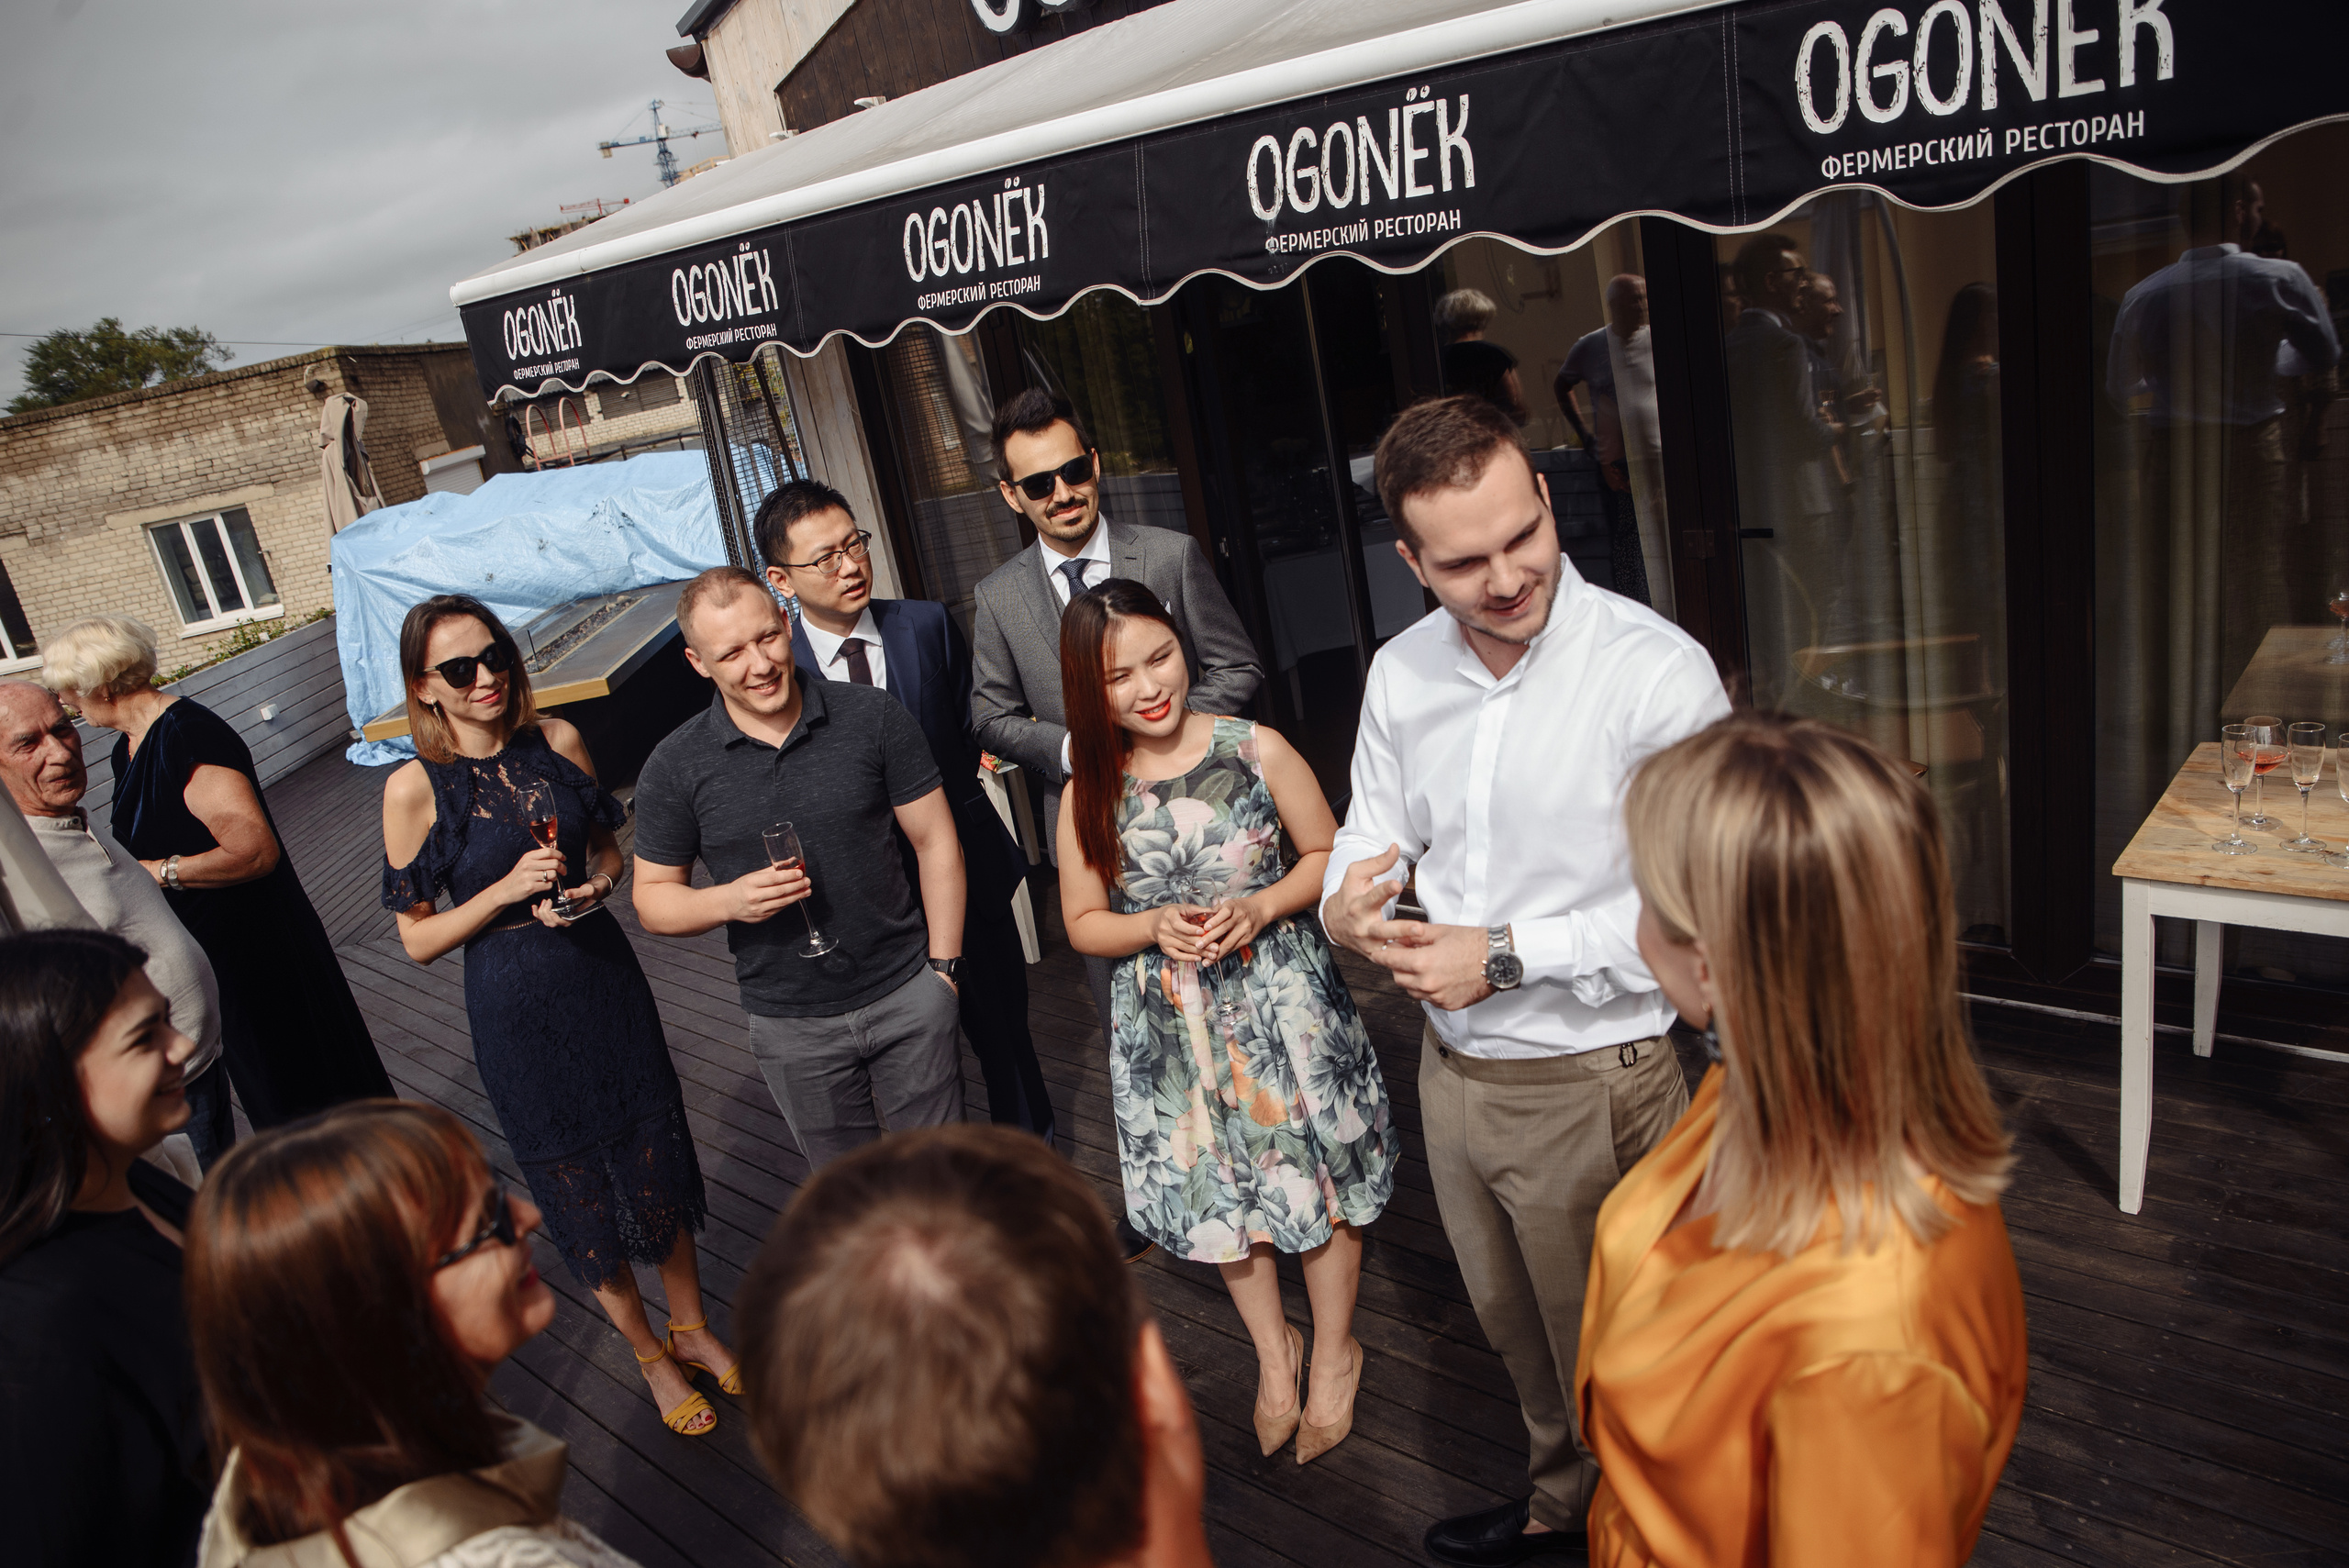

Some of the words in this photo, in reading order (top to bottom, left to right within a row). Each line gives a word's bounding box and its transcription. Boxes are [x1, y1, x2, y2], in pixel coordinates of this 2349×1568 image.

[1246, 85, 1475, 221] OGONËK
[1820, 127, 1993, 180] ФЕРМЕРСКИЙ
[2005, 110, 2145, 155] РЕСТОРАН
[903, 176, 1049, 283] OGONËK
[1265, 218, 1370, 255] ФЕРМЕРСКИЙ
[1375, 209, 1462, 239] РЕСТОРАН
[672, 242, 778, 327] OGONËK
[918, 282, 986, 310] ФЕРМЕРСКИЙ
[990, 274, 1041, 299] РЕСТОРАН
[504, 289, 582, 361] OGONËK
[685, 328, 733, 350] ФЕРМЕРСКИЙ
[735, 323, 777, 342] РЕСТОРАН
[513, 362, 552, 380] ФЕРМЕРСКИЙ
[554, 357, 580, 373] РЕСТОРАН
